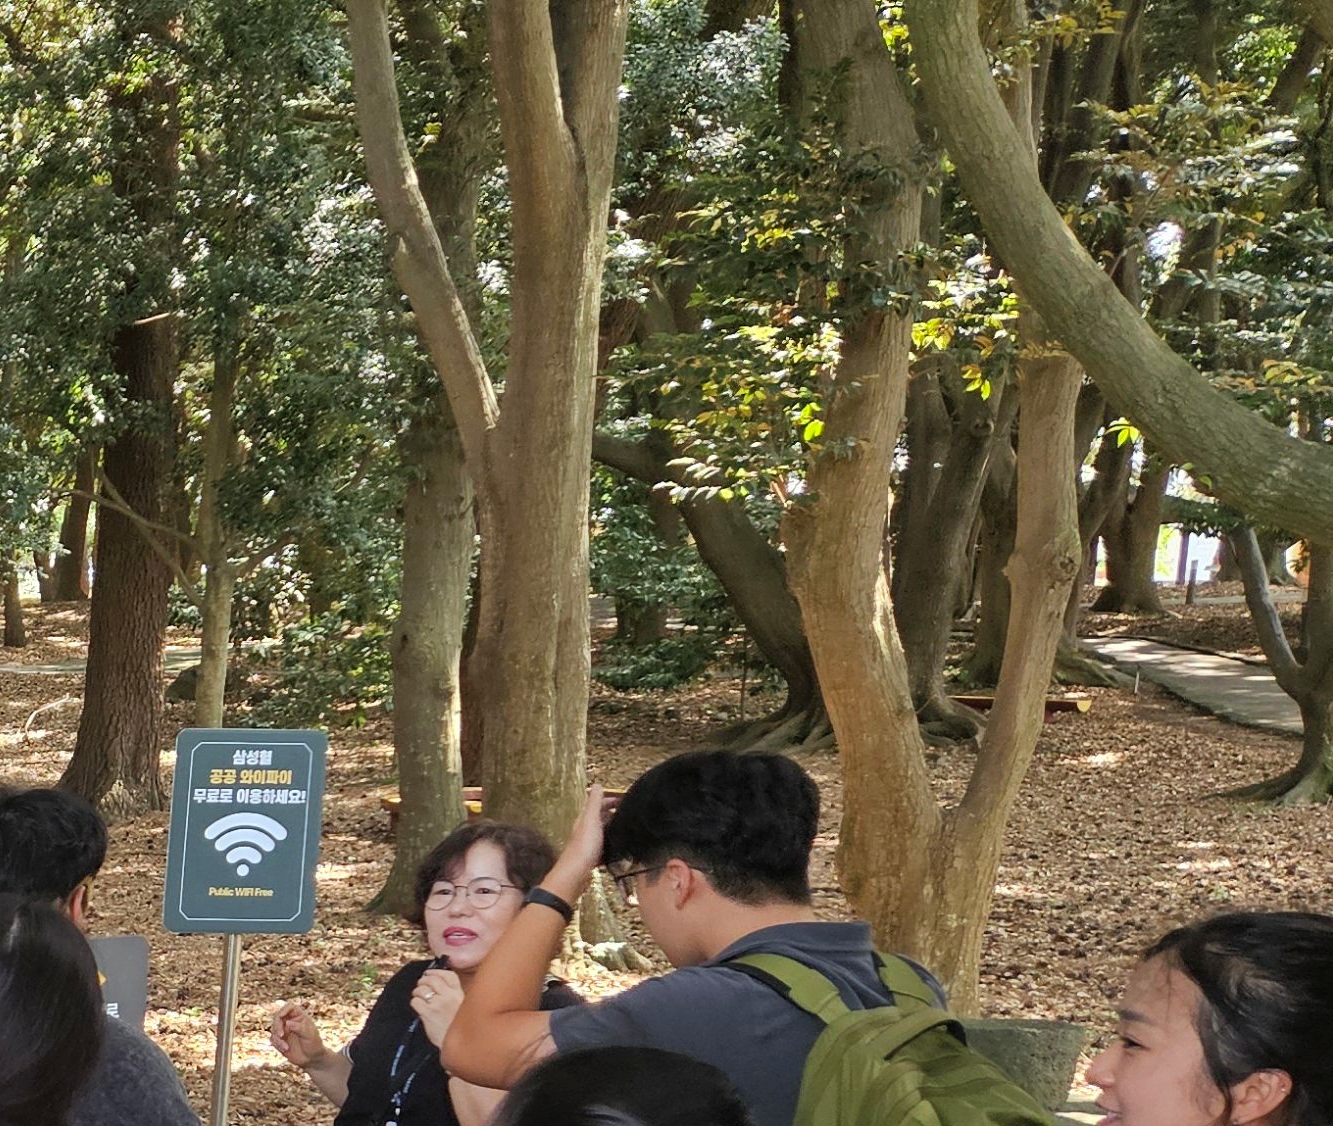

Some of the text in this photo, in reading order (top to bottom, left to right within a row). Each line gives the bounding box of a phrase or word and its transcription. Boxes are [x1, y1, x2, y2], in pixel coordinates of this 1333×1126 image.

[233, 749, 273, 766] 삼성혈
[210, 769, 293, 785] 공공 와이파이
[193, 788, 307, 805] 무료로 이용하세요!
[208, 886, 234, 897] Public
[254, 887, 274, 897] Free
